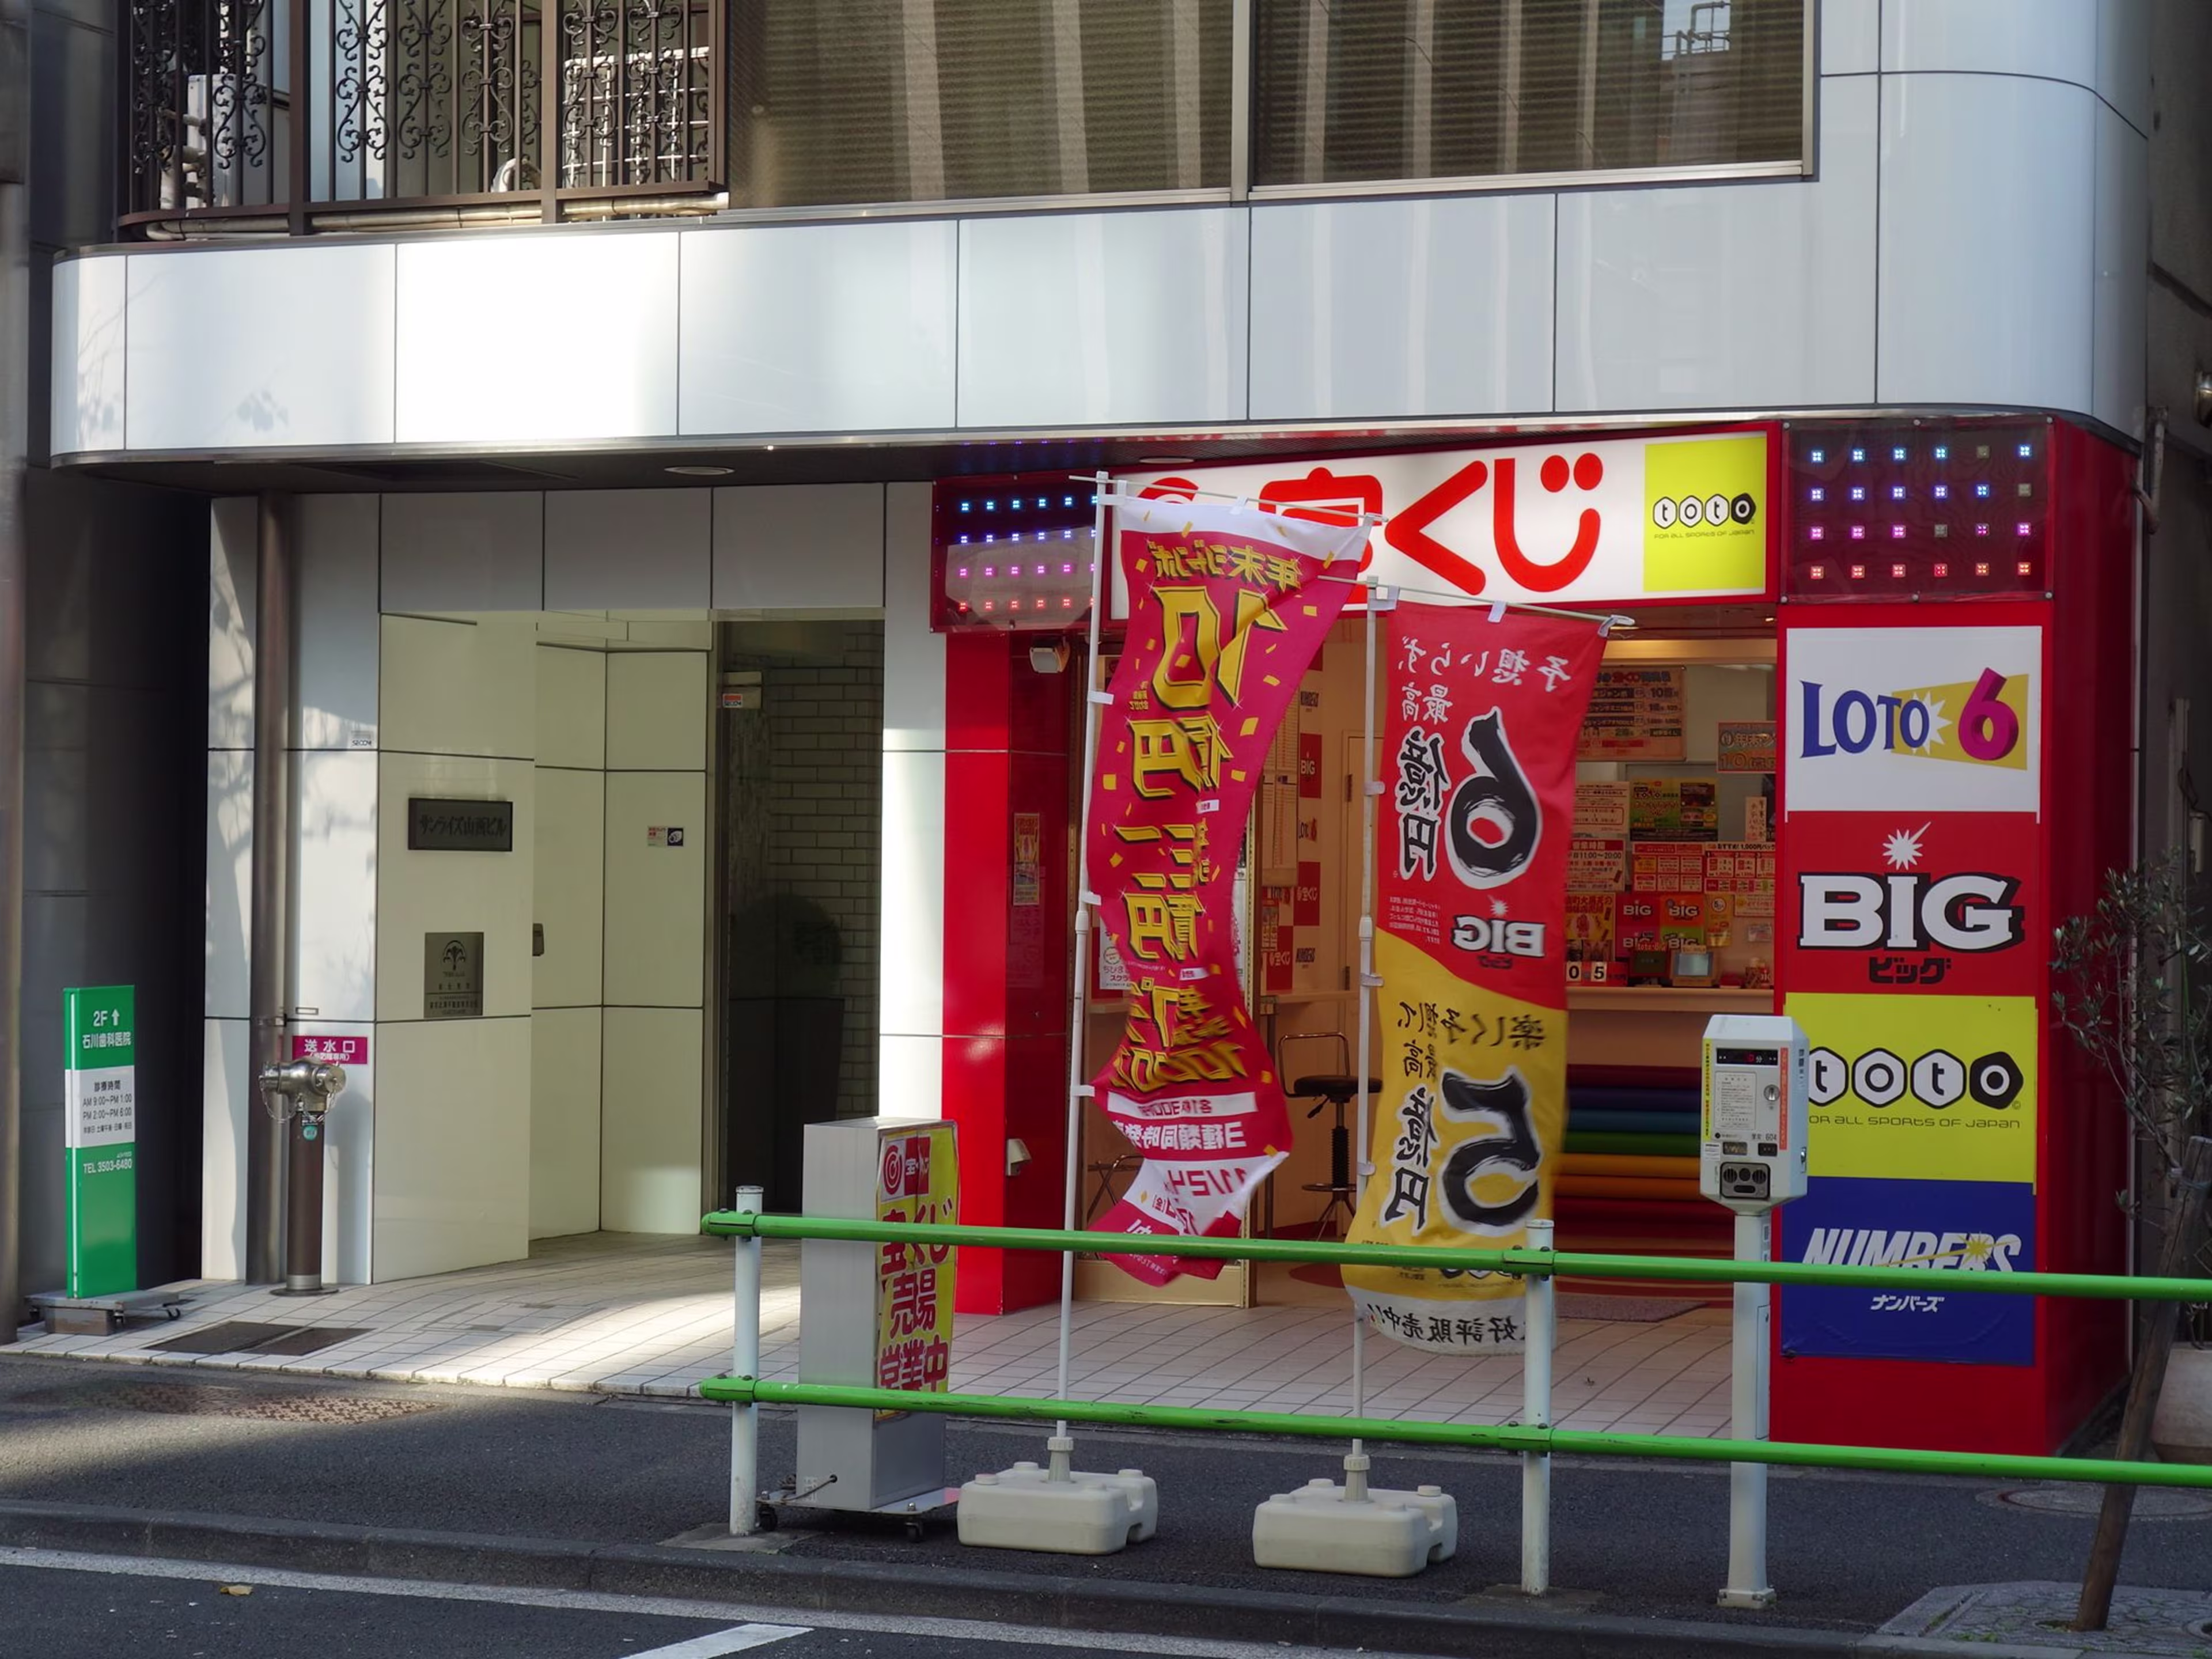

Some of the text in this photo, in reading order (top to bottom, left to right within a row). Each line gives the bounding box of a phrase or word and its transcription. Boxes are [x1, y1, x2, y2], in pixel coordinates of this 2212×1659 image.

[1653, 493, 1756, 529] toto
[1800, 667, 2019, 760] LOTO 6
[1623, 904, 1652, 916] BIG
[1798, 872, 2023, 952] BIG
[1569, 965, 1605, 979] 0 5
[1869, 957, 1951, 984] ビッグ
[93, 1010, 108, 1027] 2F
[82, 1031, 132, 1048] 石川歯科医院
[304, 1039, 355, 1053] 送水口
[1809, 1047, 2024, 1109] toto
[1809, 1115, 1830, 1124] OR
[1939, 1118, 1961, 1128] OF
[83, 1158, 132, 1174] TEL 3503-6480
[1803, 1228, 2022, 1272] NUMBERS
[889, 1268, 936, 1339] 売場
[1870, 1294, 1945, 1313] ナンバーズ
[880, 1334, 949, 1392] 営業中
